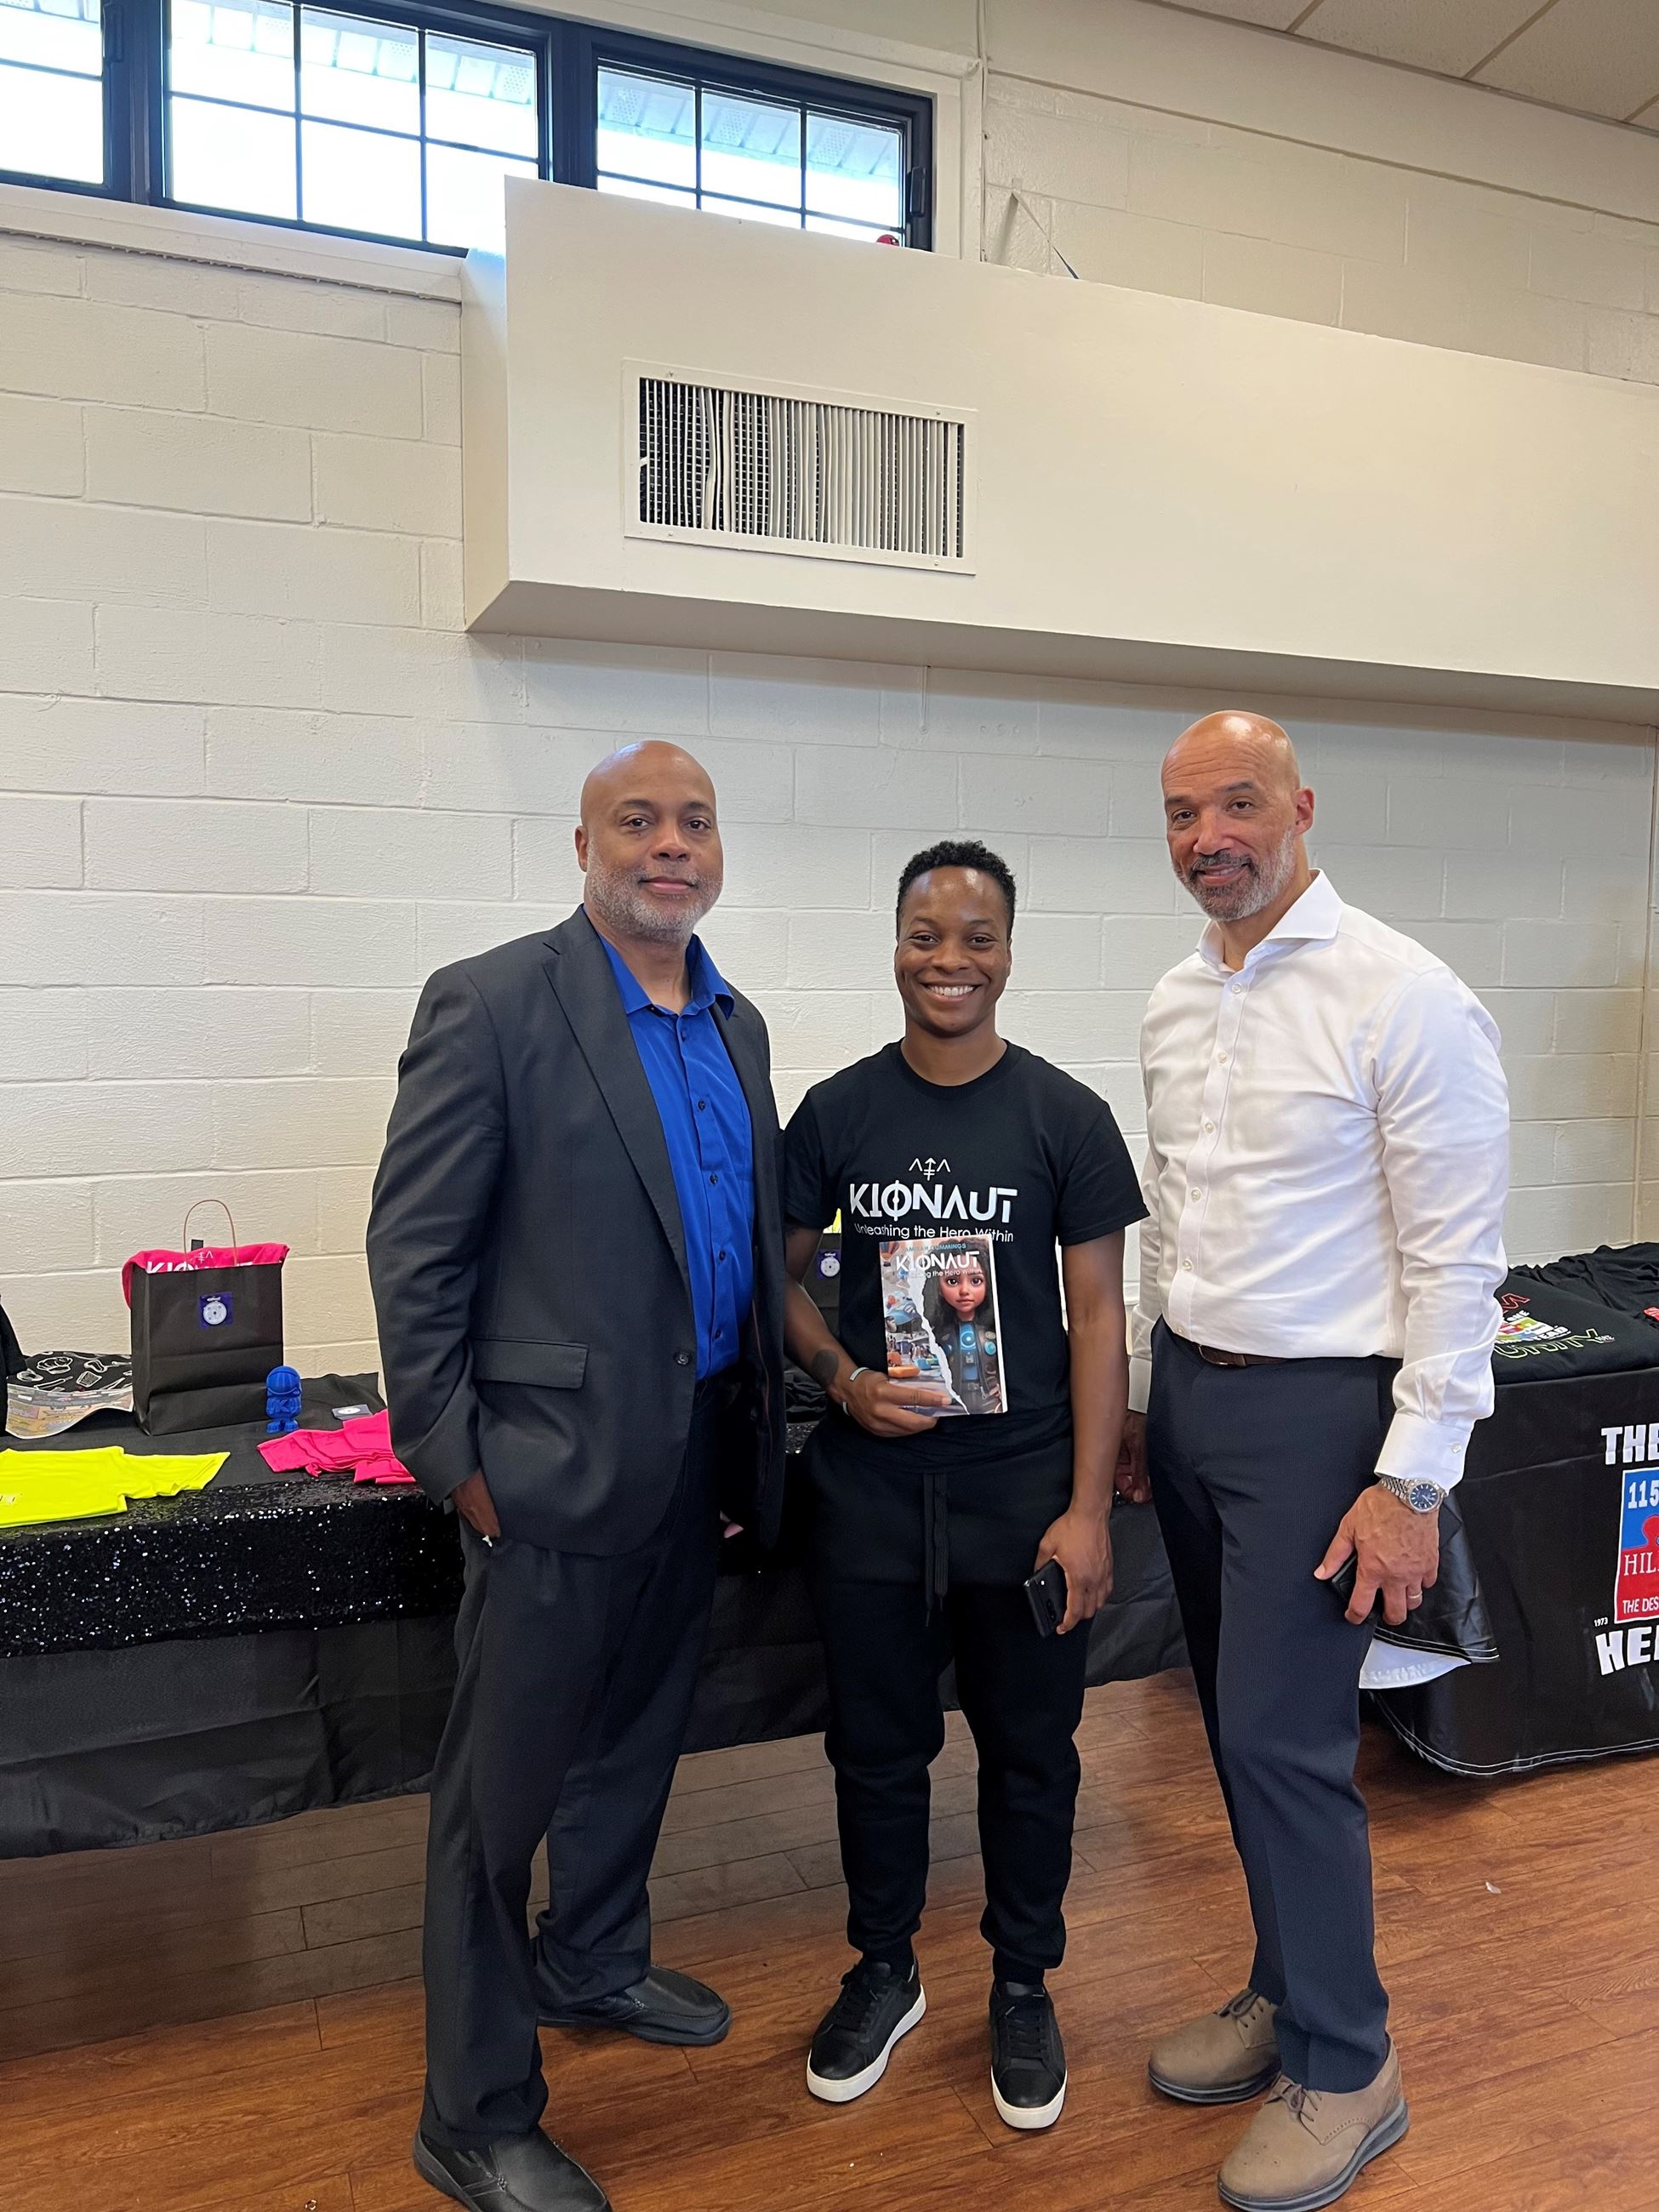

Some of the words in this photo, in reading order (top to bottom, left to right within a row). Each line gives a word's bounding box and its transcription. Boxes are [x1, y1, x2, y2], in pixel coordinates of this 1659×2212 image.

[850, 1180, 1018, 1223] KIONAUT
[853, 1223, 909, 1239] Unleashing
[914, 1225, 935, 1238] the
[940, 1226, 971, 1238] Hero
[896, 1251, 979, 1271] KIONAUT
[1623, 1552, 1659, 1576] HIL
[1622, 1599, 1639, 1614] THE
[1593, 1616, 1608, 1627] 1973
[1595, 1625, 1659, 1675] HE
